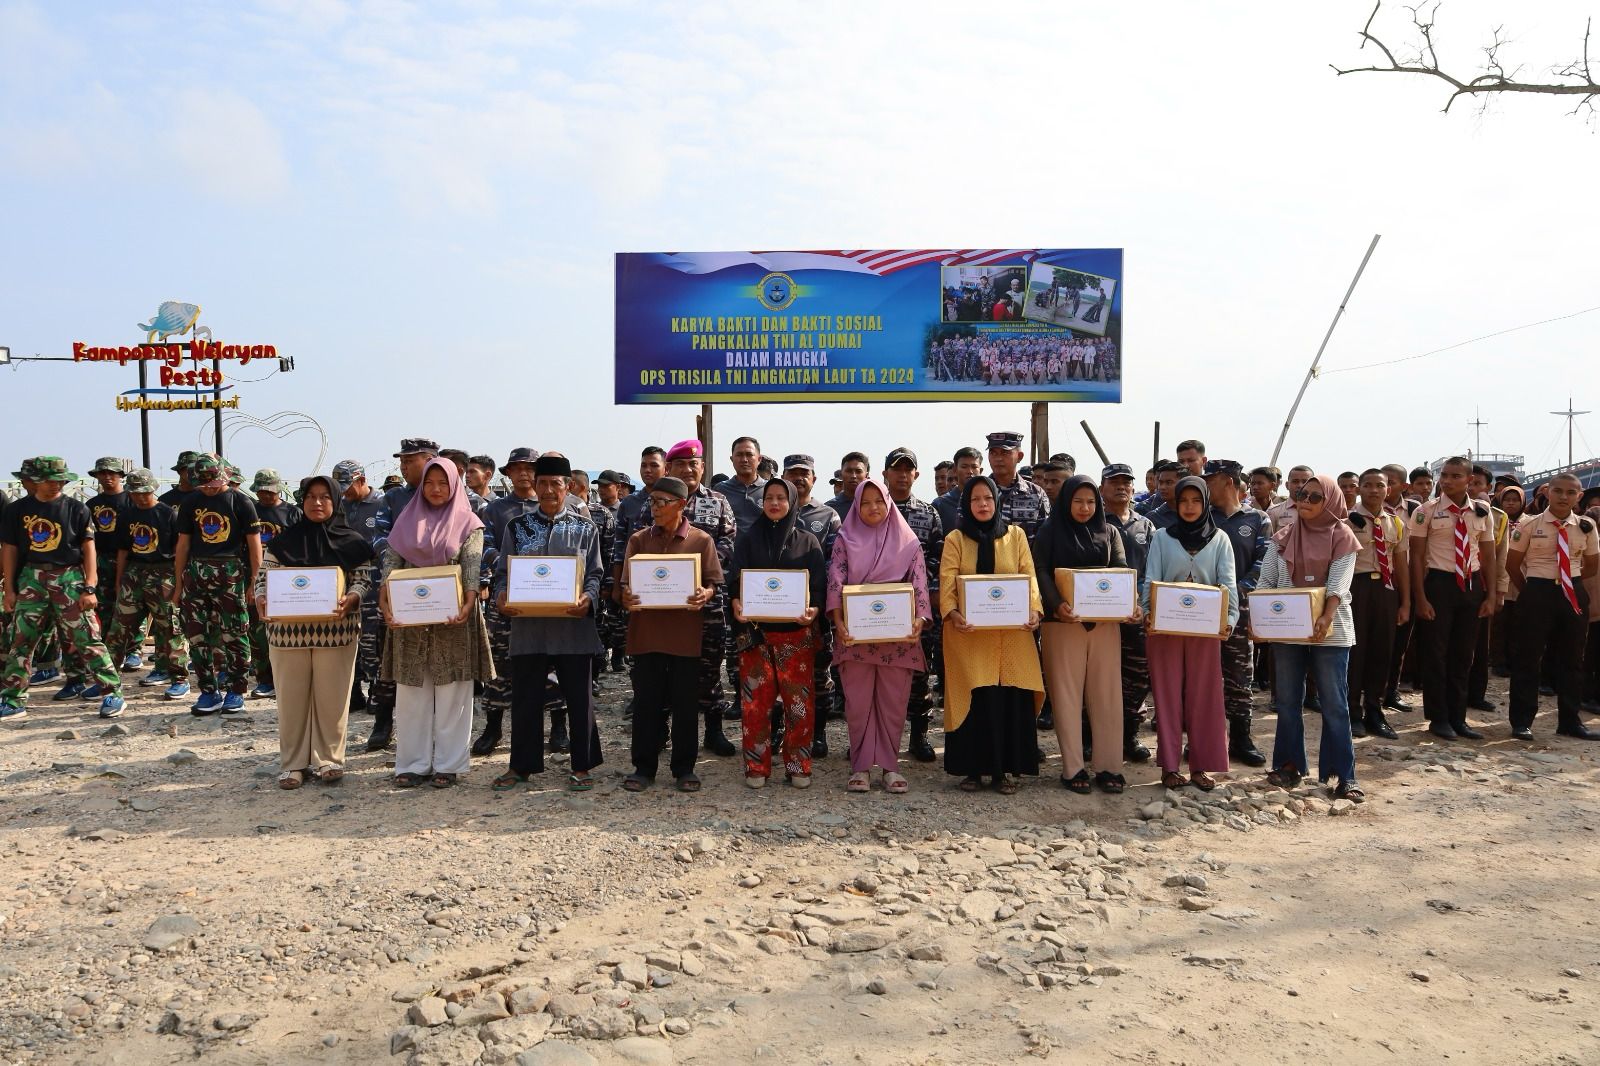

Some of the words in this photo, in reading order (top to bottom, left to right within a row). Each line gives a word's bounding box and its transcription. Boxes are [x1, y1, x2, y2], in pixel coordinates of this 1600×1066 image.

[671, 317, 713, 333] KARYA
[717, 316, 757, 332] BAKTI
[761, 316, 788, 332] DAN
[792, 315, 832, 331] BAKTI
[836, 315, 883, 331] SOSIAL
[692, 334, 769, 350] PANGKALAN
[773, 333, 795, 349] TNI
[799, 333, 814, 349] AL
[818, 333, 862, 349] DUMAI
[73, 341, 183, 367] Kampoeng
[190, 340, 277, 365] Nelayan
[726, 352, 770, 367] DALAM
[774, 351, 828, 367] RANGKA
[640, 370, 666, 386] OPS
[670, 370, 722, 385] TRISILA
[726, 370, 747, 385] TNI
[751, 369, 820, 385] ANGKATAN
[824, 369, 857, 384] LAUT
[861, 369, 876, 384] TA
[880, 368, 915, 384] 2024
